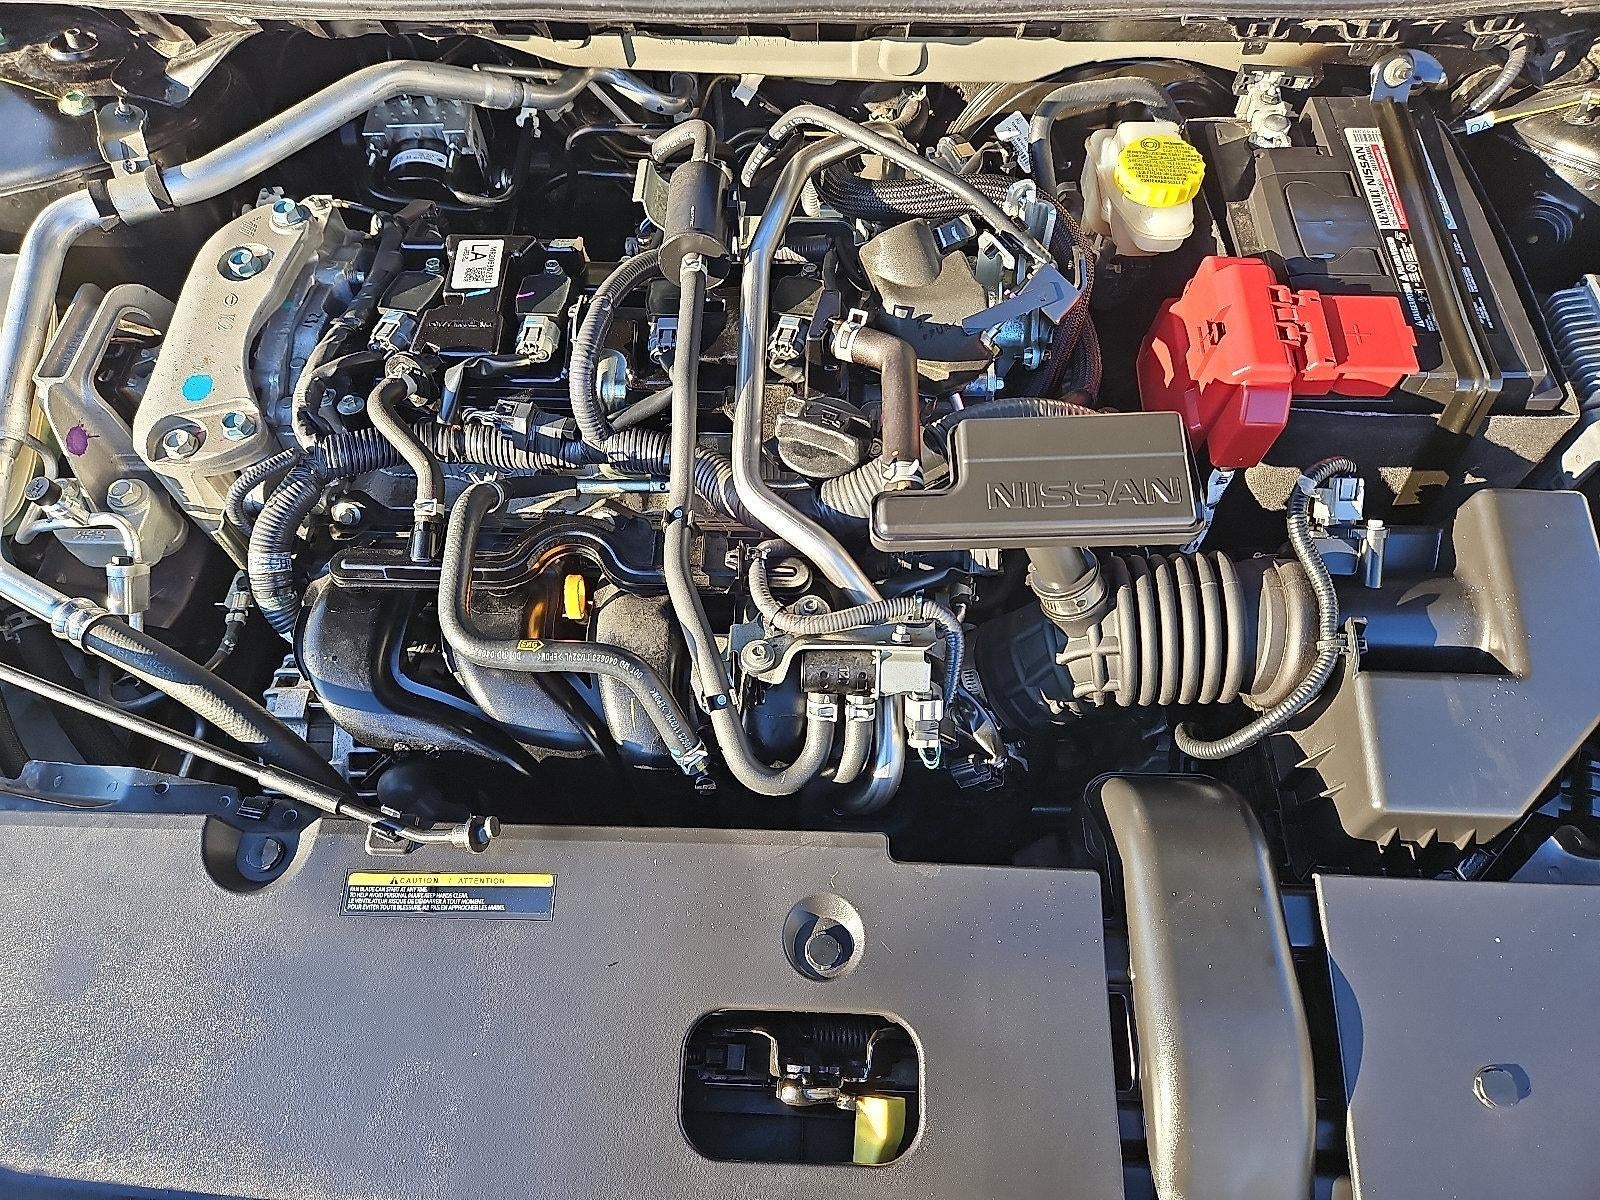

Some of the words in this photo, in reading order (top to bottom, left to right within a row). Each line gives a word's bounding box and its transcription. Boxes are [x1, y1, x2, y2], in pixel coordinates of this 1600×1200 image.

[1354, 146, 1376, 186] NISSAN
[1369, 188, 1392, 227] RENAULT
[469, 244, 489, 261] LA
[986, 477, 1182, 510] NISSAN
